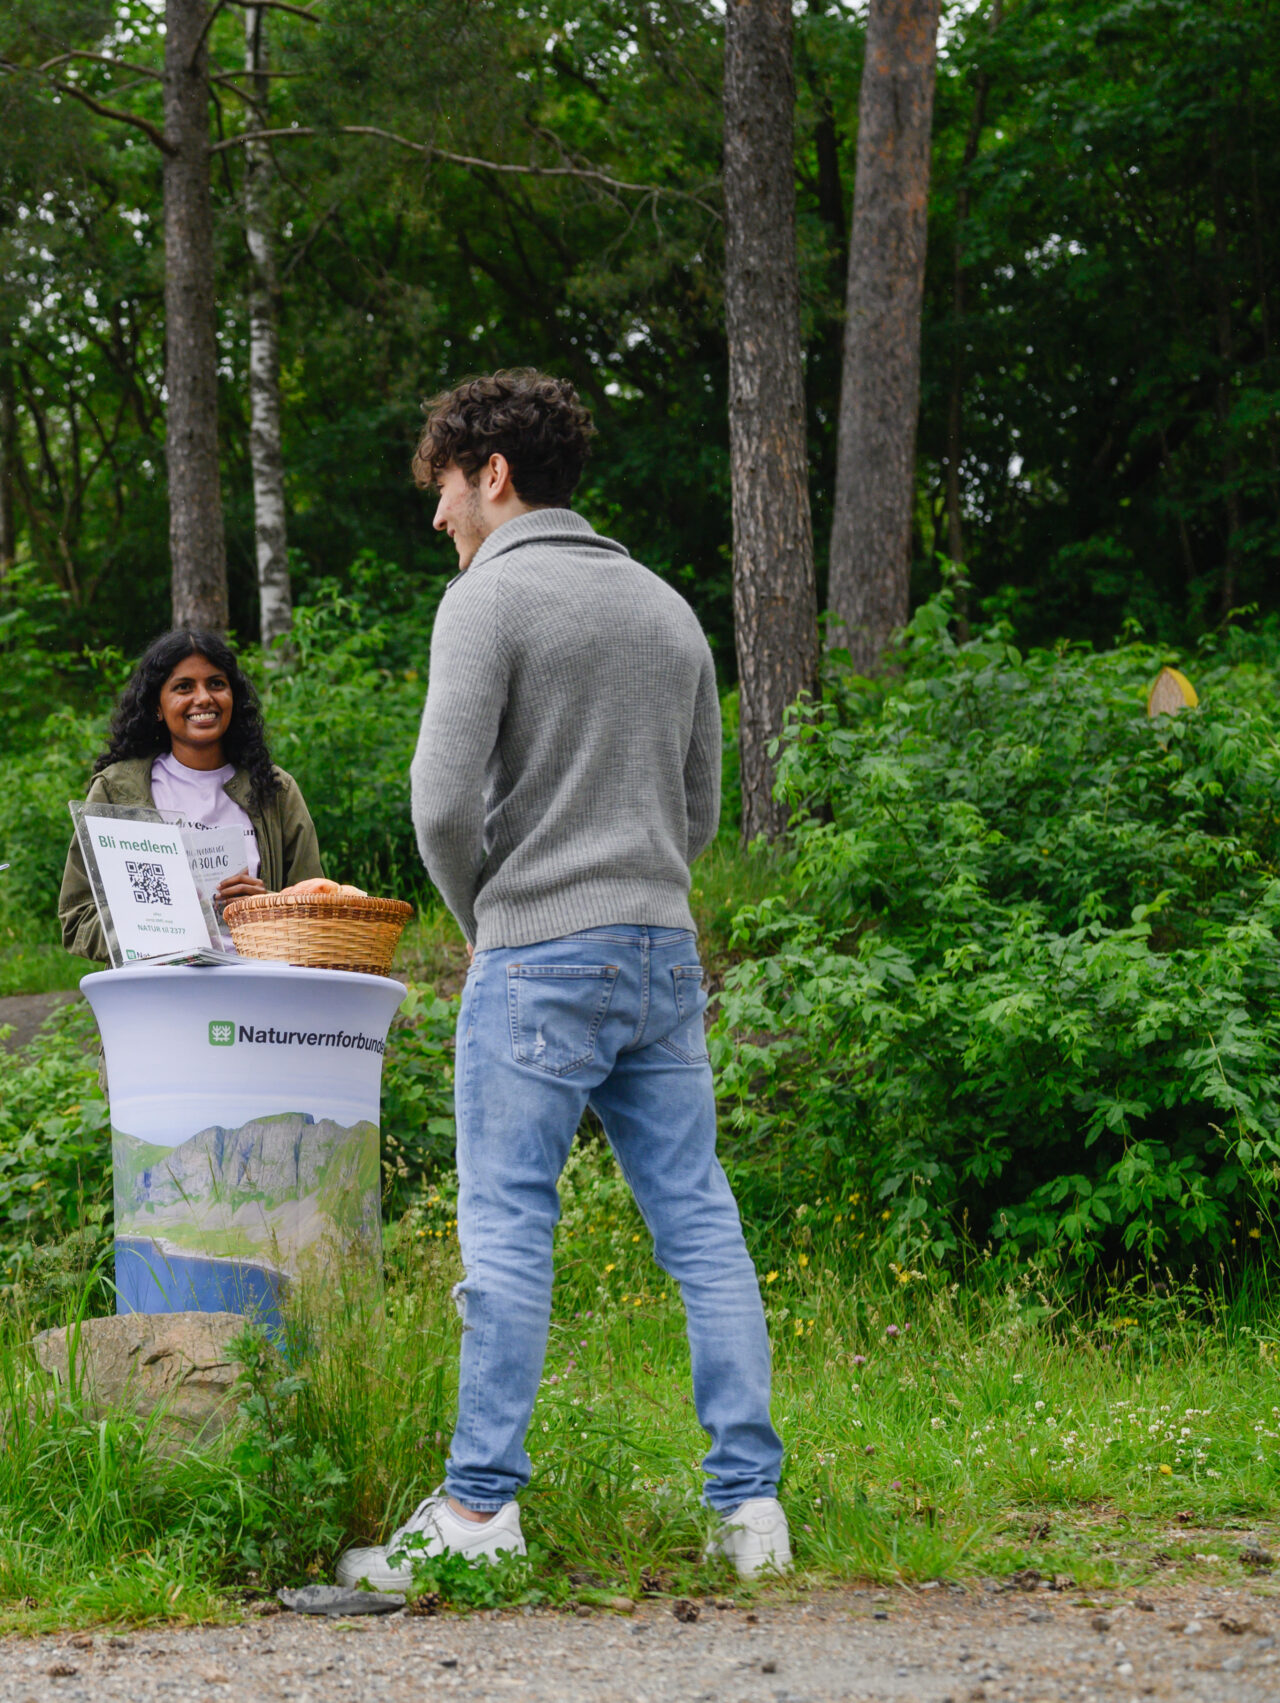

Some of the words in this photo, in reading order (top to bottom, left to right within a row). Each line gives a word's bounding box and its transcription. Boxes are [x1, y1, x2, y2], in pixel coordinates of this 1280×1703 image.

[98, 835, 116, 849] Bli
[119, 839, 178, 855] medlem!
[137, 924, 161, 933] NATUR
